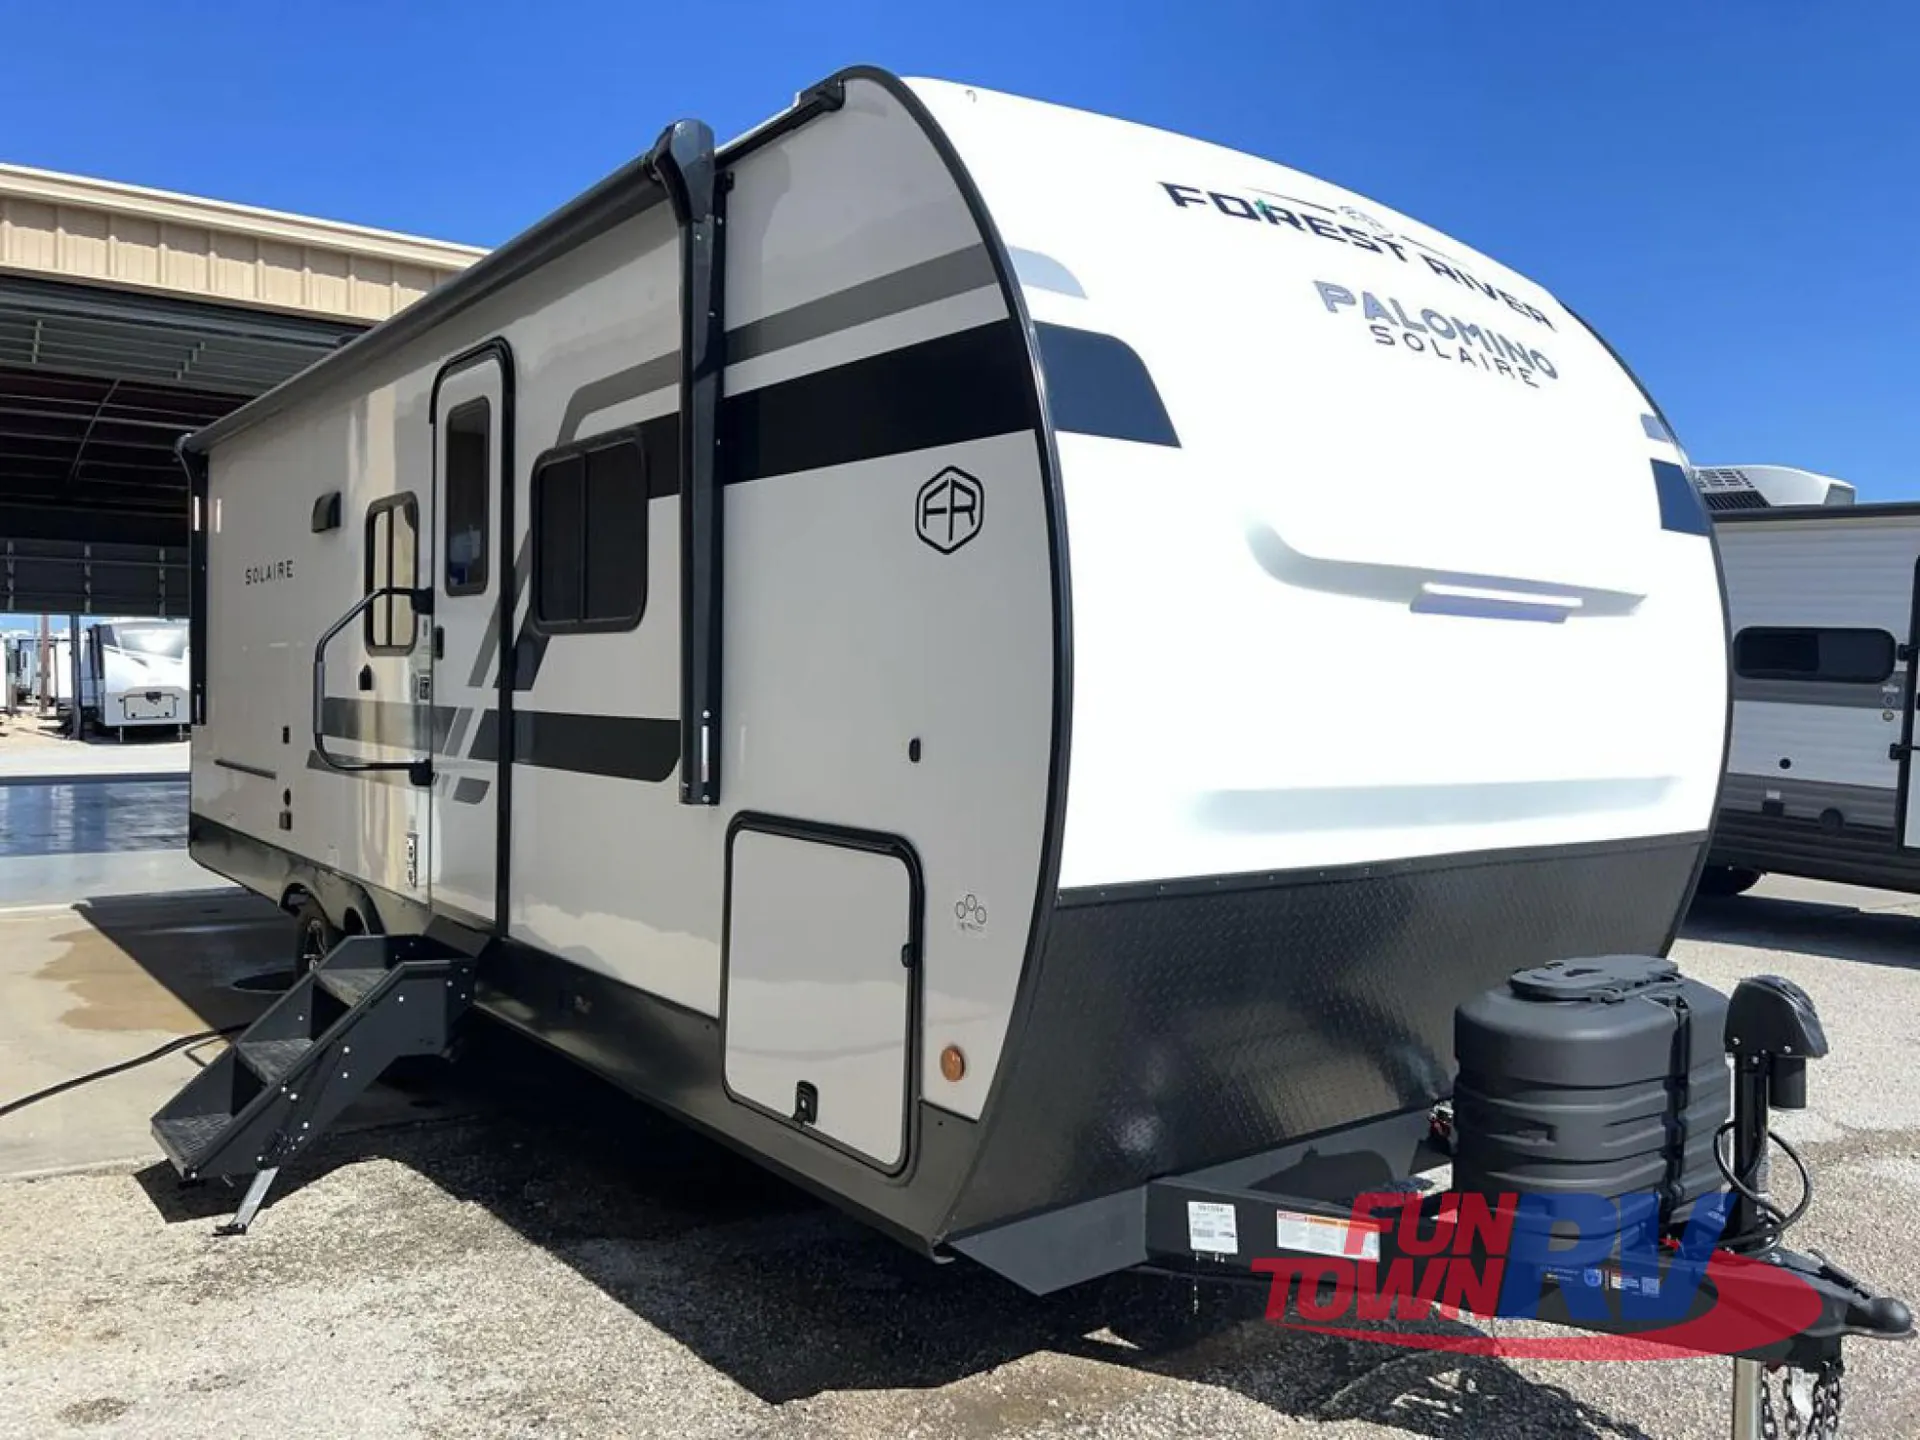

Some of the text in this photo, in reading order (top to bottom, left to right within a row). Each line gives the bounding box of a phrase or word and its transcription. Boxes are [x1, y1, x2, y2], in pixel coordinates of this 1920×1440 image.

[1157, 181, 1557, 331] FOREST RIVER
[1313, 280, 1558, 379] PALOMINO
[1370, 324, 1540, 388] SOLAIRE
[245, 560, 294, 586] SOLAIRE
